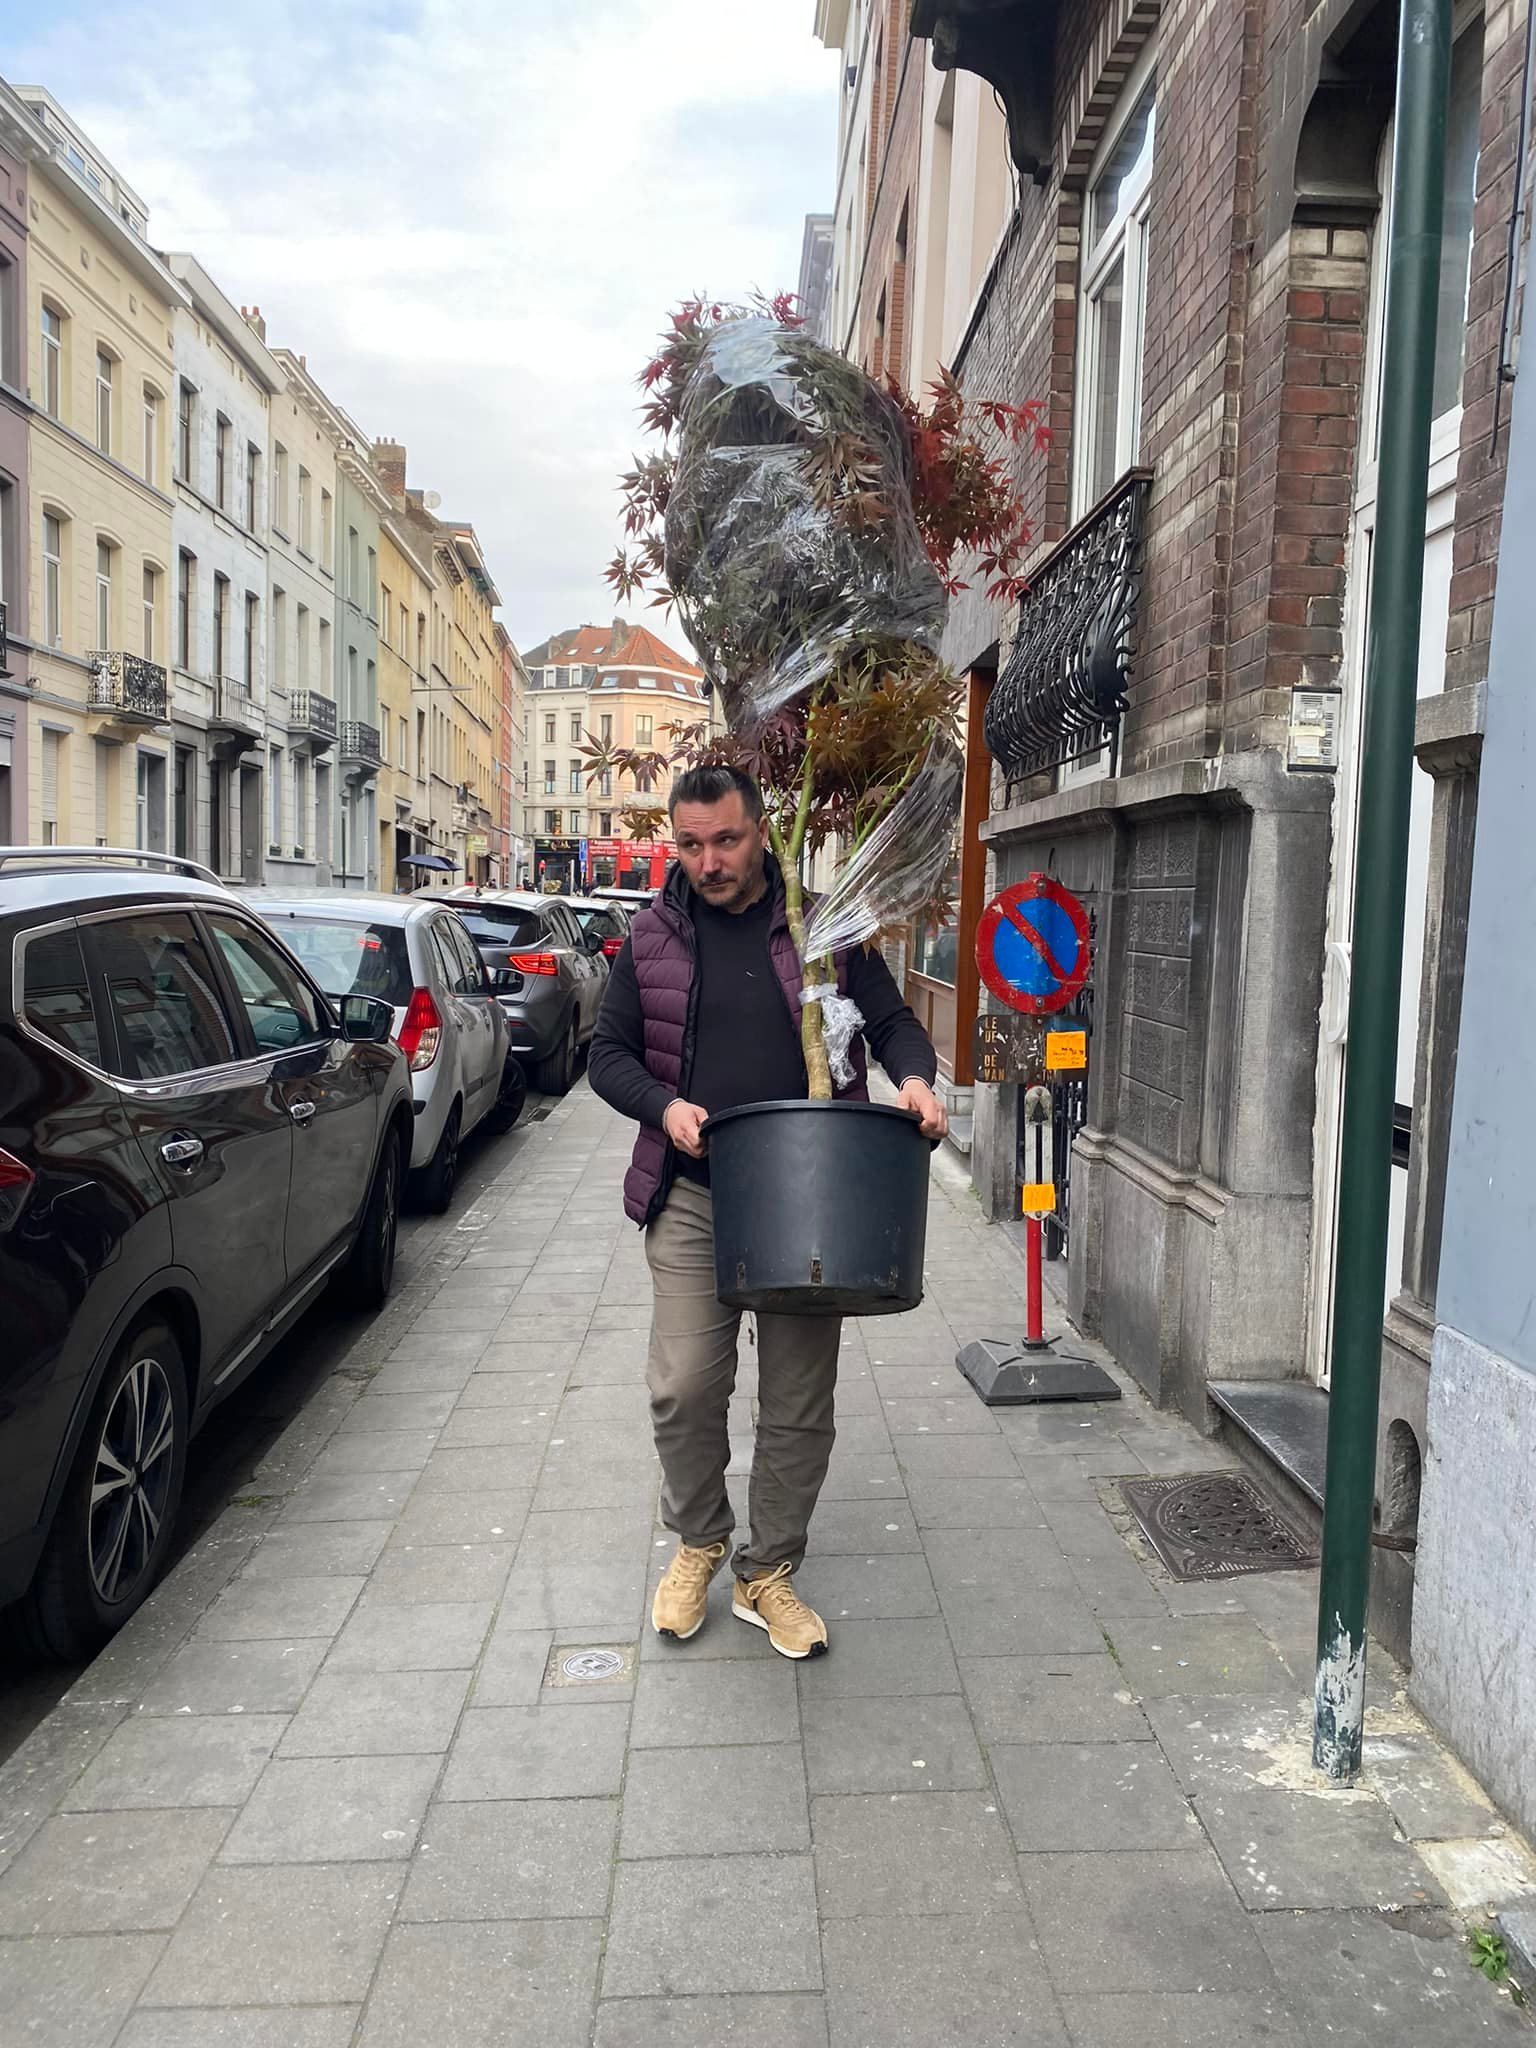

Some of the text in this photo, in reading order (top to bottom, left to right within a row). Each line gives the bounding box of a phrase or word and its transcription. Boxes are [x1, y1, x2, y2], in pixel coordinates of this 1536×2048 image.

[984, 1016, 997, 1030] LE
[984, 1054, 997, 1068] DE
[984, 1068, 1006, 1081] VAN
